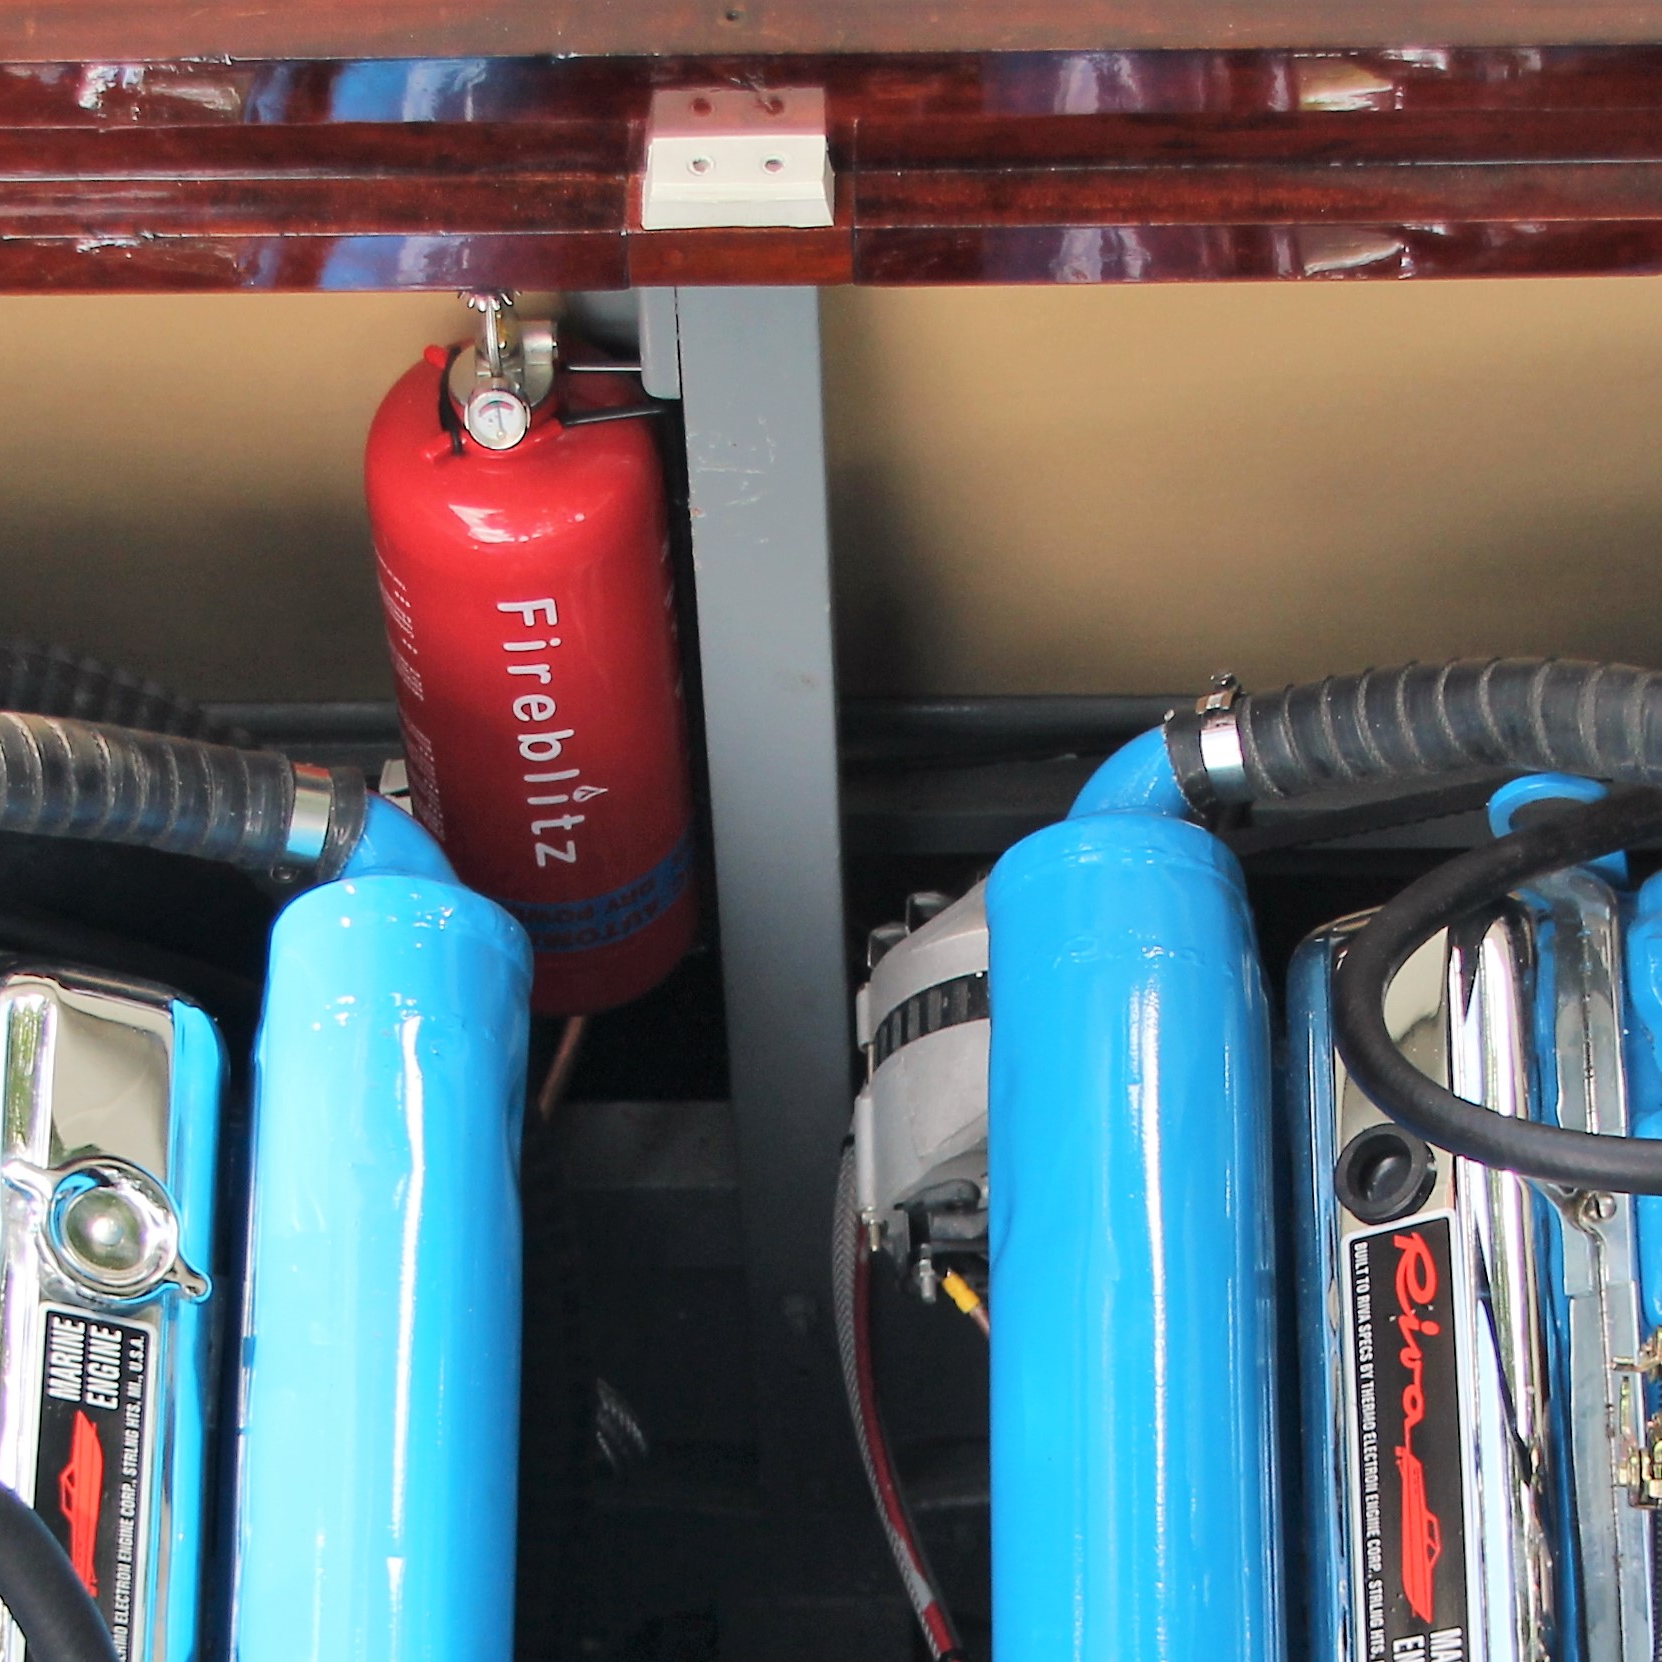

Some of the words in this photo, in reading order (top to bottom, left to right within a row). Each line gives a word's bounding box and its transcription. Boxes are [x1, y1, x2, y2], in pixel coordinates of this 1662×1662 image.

[497, 597, 596, 868] Fireblitz
[1353, 1241, 1370, 1274] BUILT
[1355, 1278, 1371, 1294] TO
[1356, 1296, 1373, 1322] RIVA
[1357, 1323, 1375, 1363] SPECS
[1392, 1231, 1442, 1428] Riva
[47, 1316, 86, 1402] MARINE
[86, 1325, 123, 1409] ENGINE
[129, 1335, 146, 1372] U.S.A.
[1359, 1364, 1375, 1381] BY
[1360, 1382, 1377, 1431] THERMO
[123, 1430, 141, 1477] STRLNG
[1362, 1432, 1380, 1493] ELECTRON
[117, 1517, 135, 1562] ENGINE
[1364, 1495, 1382, 1538] ENGINE
[114, 1564, 133, 1625] ELECTRON
[1368, 1580, 1386, 1628] STRLNG
